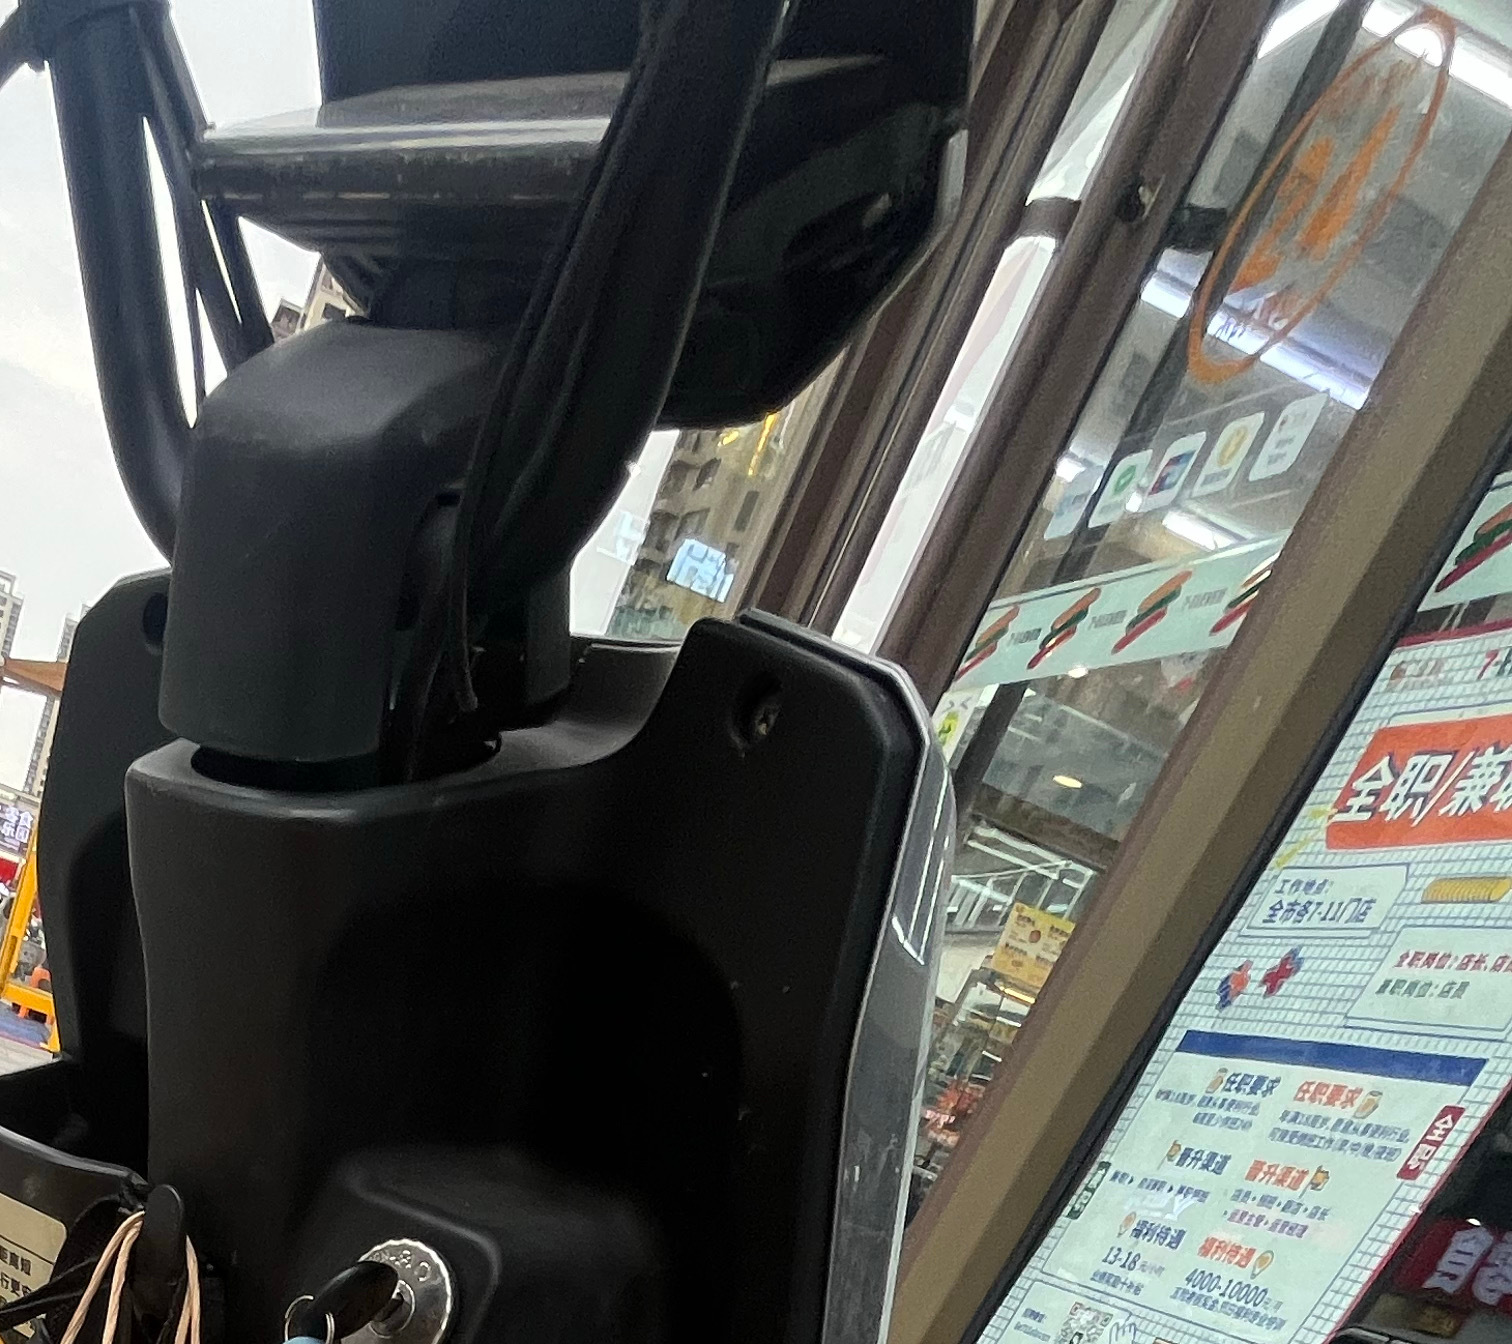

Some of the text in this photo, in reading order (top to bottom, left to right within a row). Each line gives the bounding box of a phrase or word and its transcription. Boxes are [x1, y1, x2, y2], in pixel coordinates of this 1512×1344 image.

[1262, 898, 1378, 925] 全市各7-11门店
[1221, 1071, 1282, 1098] 任职要求
[1292, 1080, 1364, 1109] 任职要求
[1176, 1146, 1232, 1176] 晋升渠道
[1244, 1159, 1310, 1191] 晋升渠道
[1130, 1219, 1187, 1250] 福利待遇
[1197, 1236, 1257, 1269] 福利待遇
